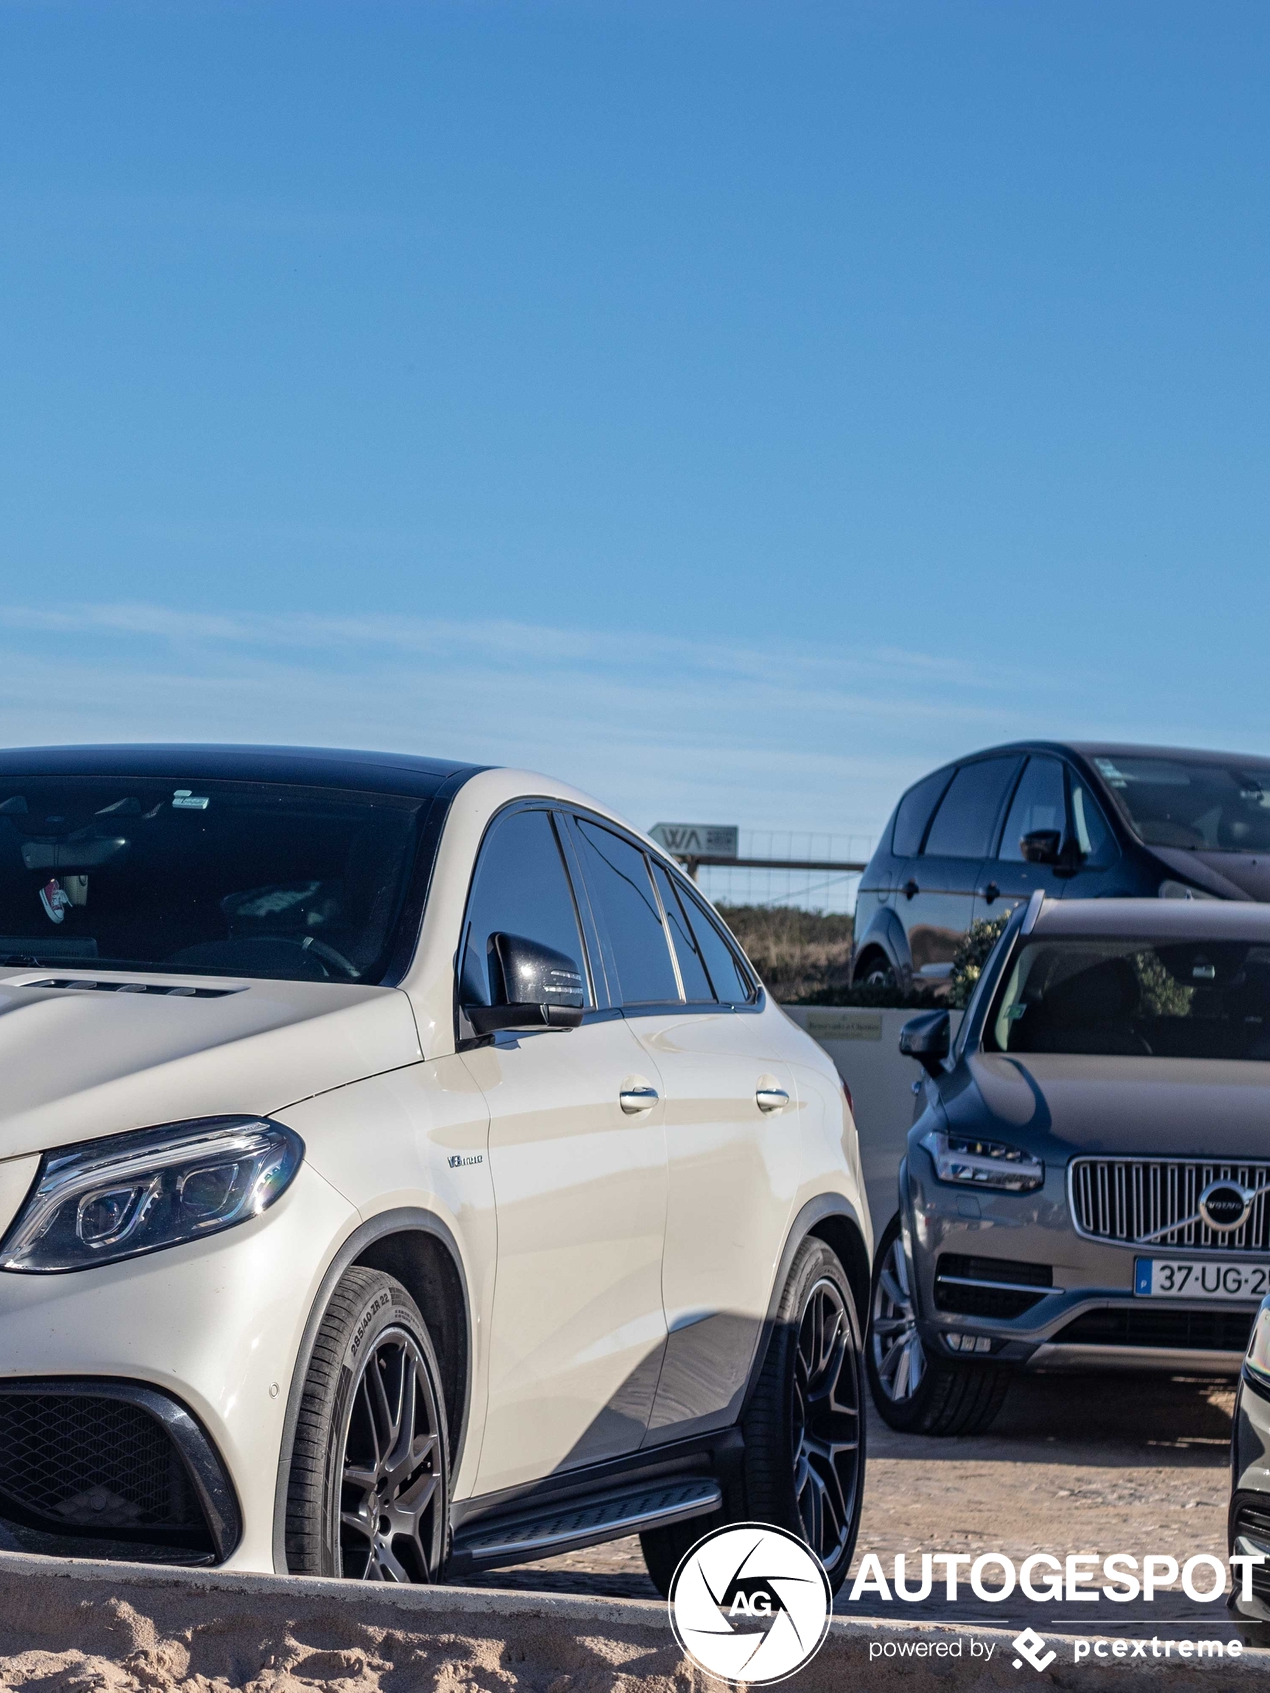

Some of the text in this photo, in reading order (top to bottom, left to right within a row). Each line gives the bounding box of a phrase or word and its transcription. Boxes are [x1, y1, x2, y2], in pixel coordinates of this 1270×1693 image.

[1207, 1202, 1244, 1211] VOLVO
[350, 1293, 390, 1357] 285/40 ZR 22
